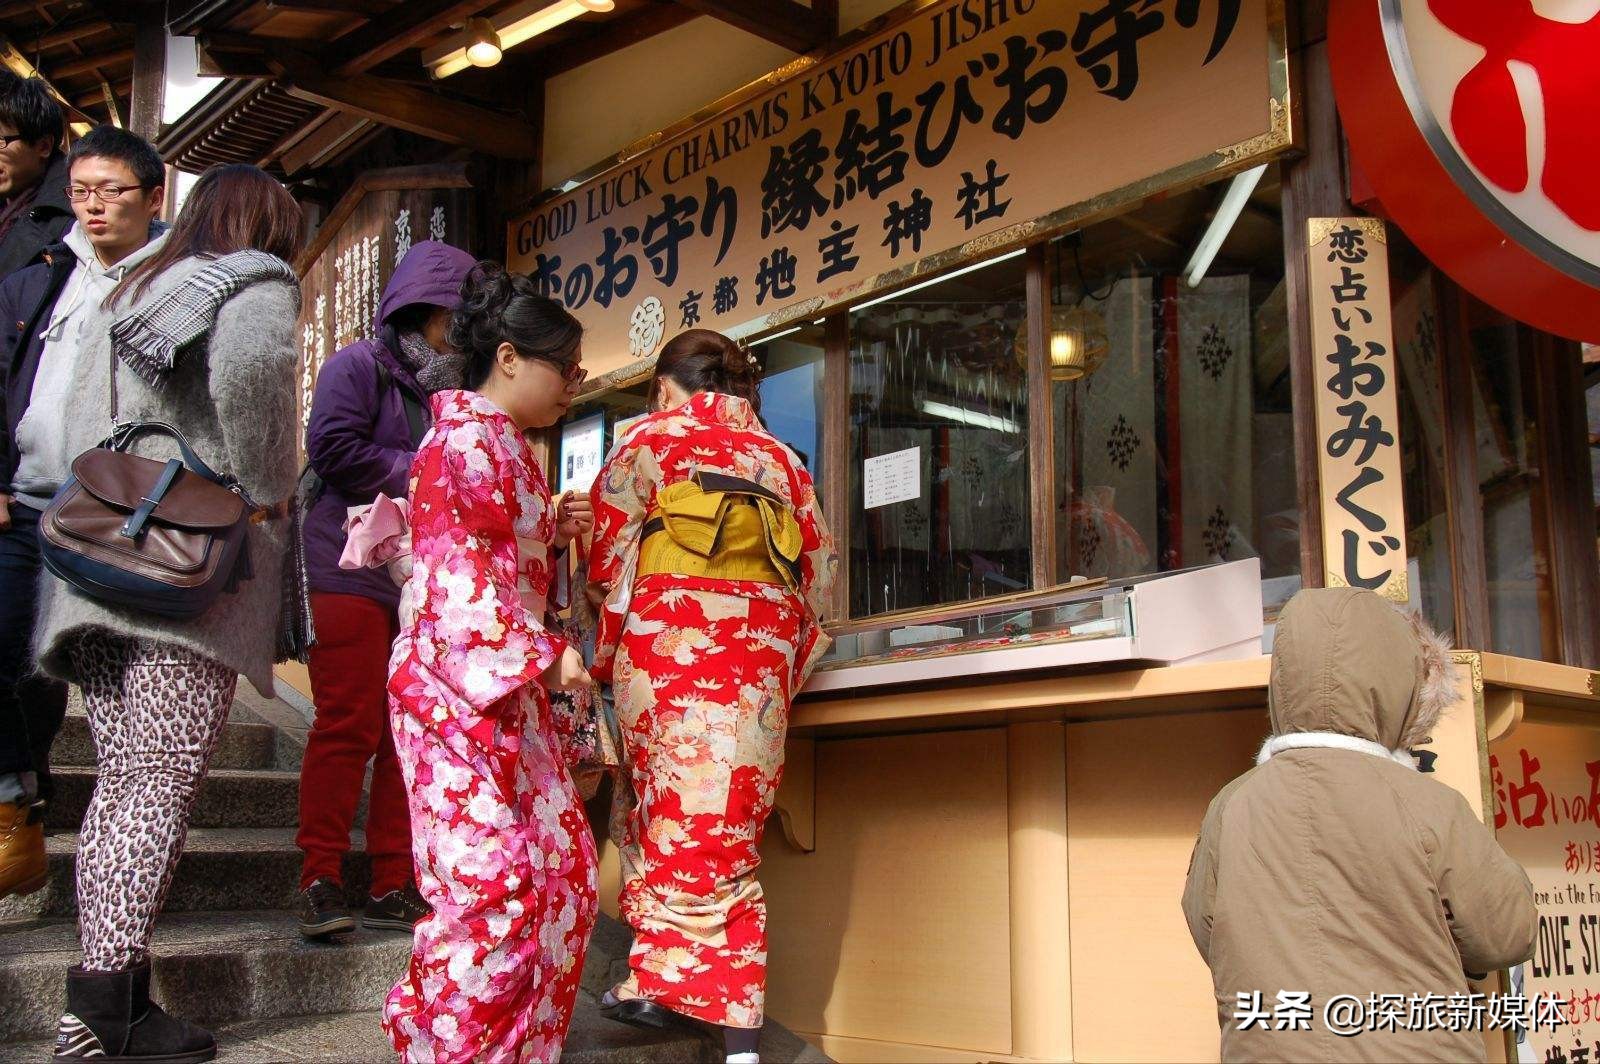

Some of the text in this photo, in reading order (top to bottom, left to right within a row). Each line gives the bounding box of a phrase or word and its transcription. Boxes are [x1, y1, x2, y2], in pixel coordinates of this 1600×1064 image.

[517, 199, 577, 256] GOOD
[586, 160, 654, 225] LUCK
[662, 90, 789, 186] CHARMS
[800, 31, 912, 122] KYOTO
[1326, 225, 1401, 589] 恋占いおみくじ
[1534, 891, 1550, 906] ere
[1554, 886, 1565, 905] is
[1567, 884, 1586, 905] the
[1580, 914, 1600, 975] ST
